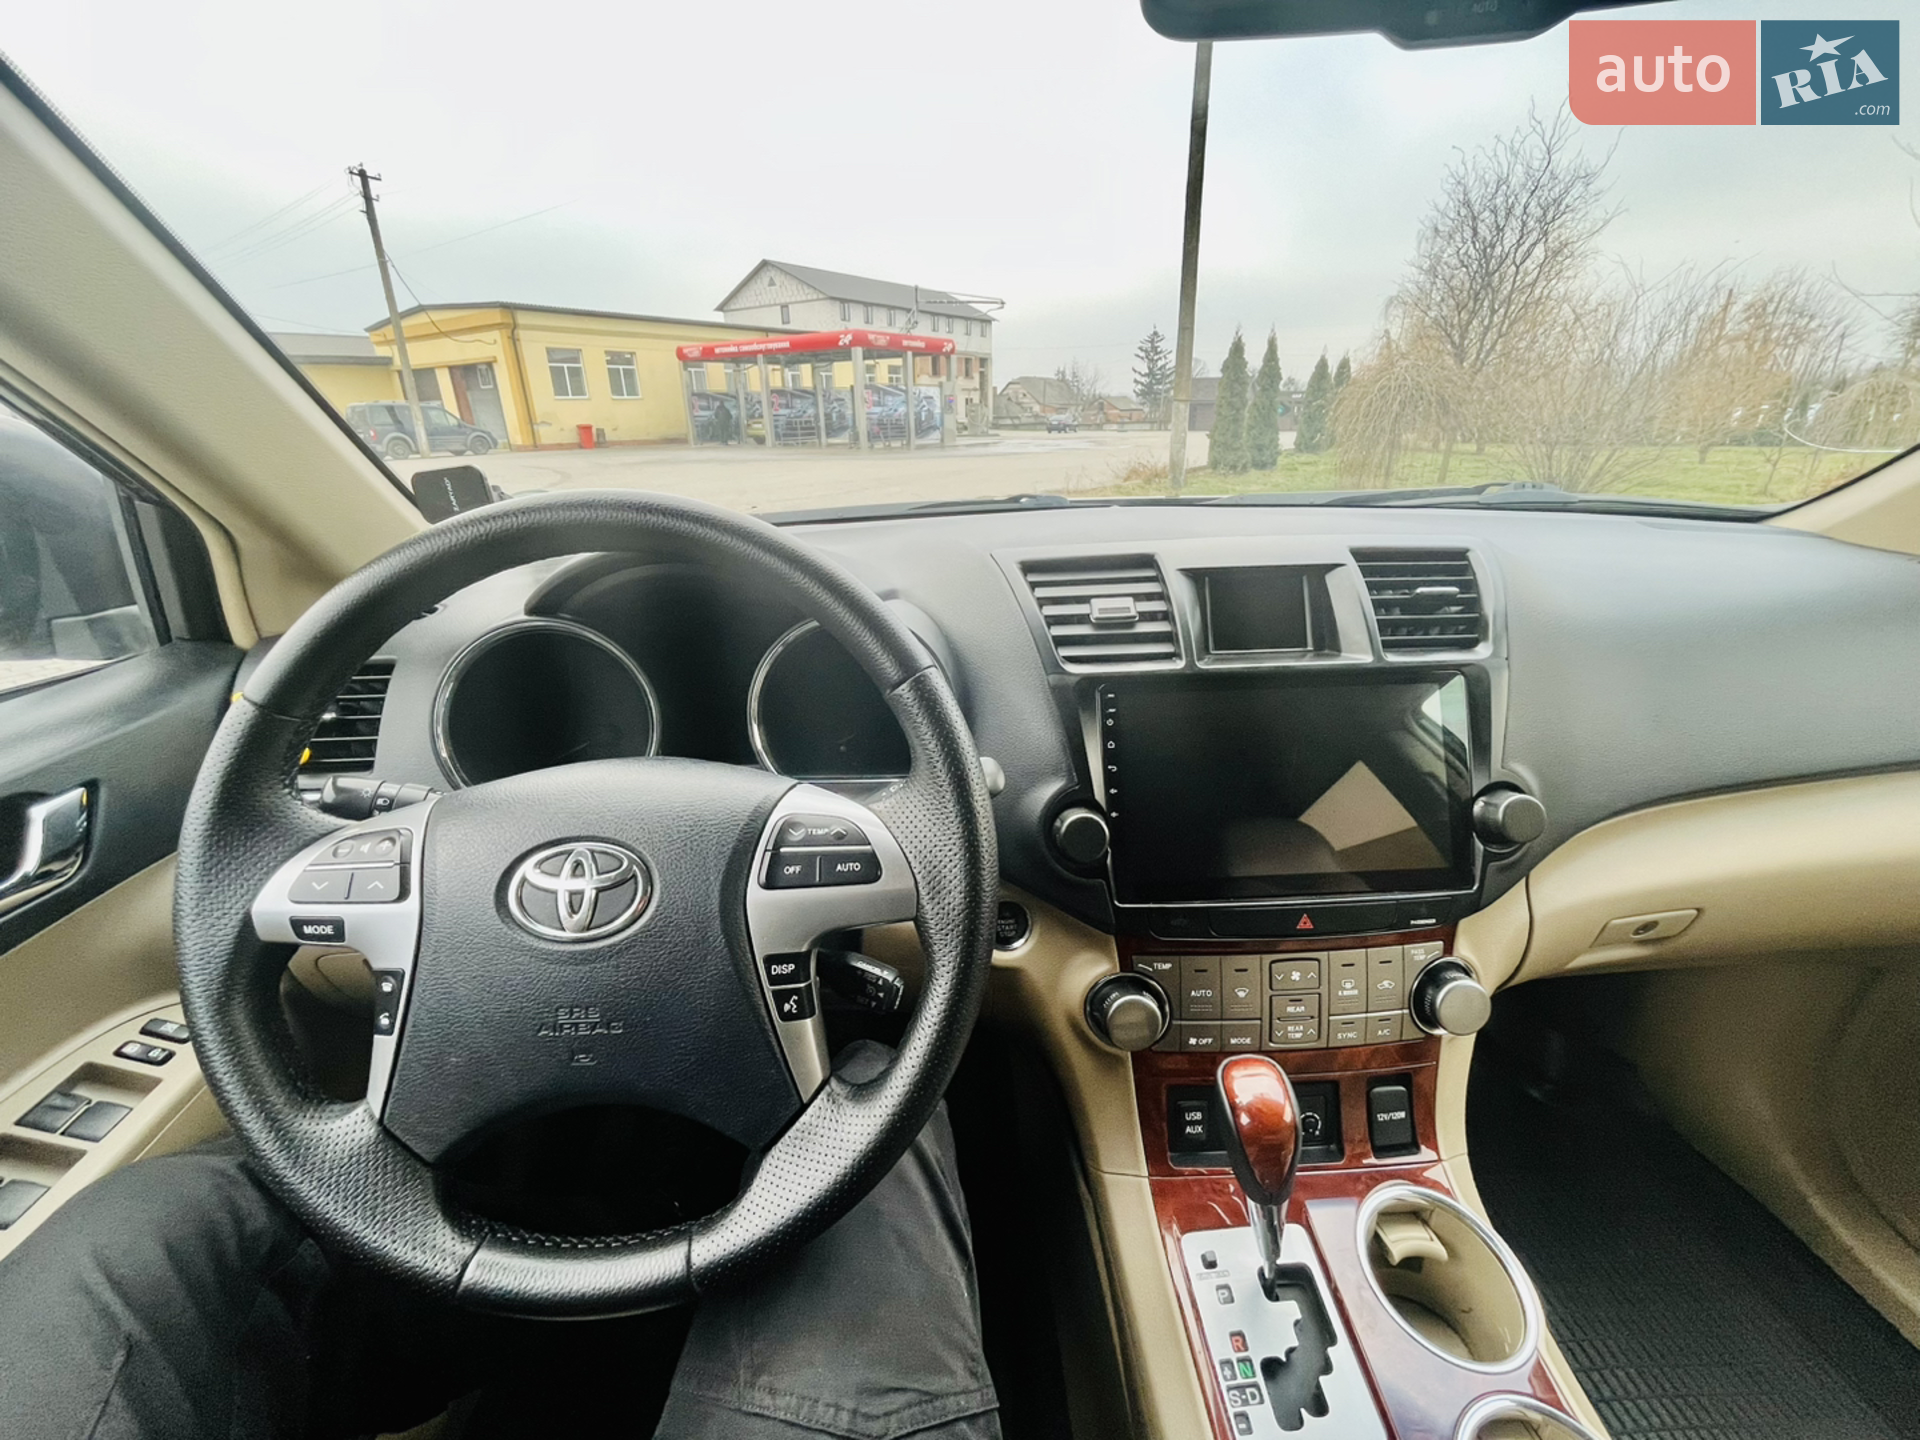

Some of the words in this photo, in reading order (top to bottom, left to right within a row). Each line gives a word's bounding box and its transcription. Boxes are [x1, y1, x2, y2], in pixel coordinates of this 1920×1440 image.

[808, 827, 829, 835] TEMP
[783, 865, 802, 875] OFF
[835, 862, 861, 872] AUTO
[303, 925, 334, 935] MODE
[771, 963, 796, 976] DISP
[1153, 962, 1173, 970] TEMP
[1190, 989, 1213, 998] AUTO
[558, 1007, 600, 1019] SRS
[1286, 1005, 1306, 1014] REAR
[538, 1021, 625, 1036] AIRBAG
[1377, 1028, 1391, 1036] A/C
[1337, 1031, 1358, 1040] SYNC
[1198, 1037, 1214, 1045] OFF
[1229, 1037, 1252, 1045] MODE
[1185, 1111, 1203, 1121] USB
[1185, 1125, 1204, 1134] AUX
[1218, 1290, 1230, 1304] P
[1231, 1335, 1245, 1351] R
[1239, 1362, 1254, 1378] N
